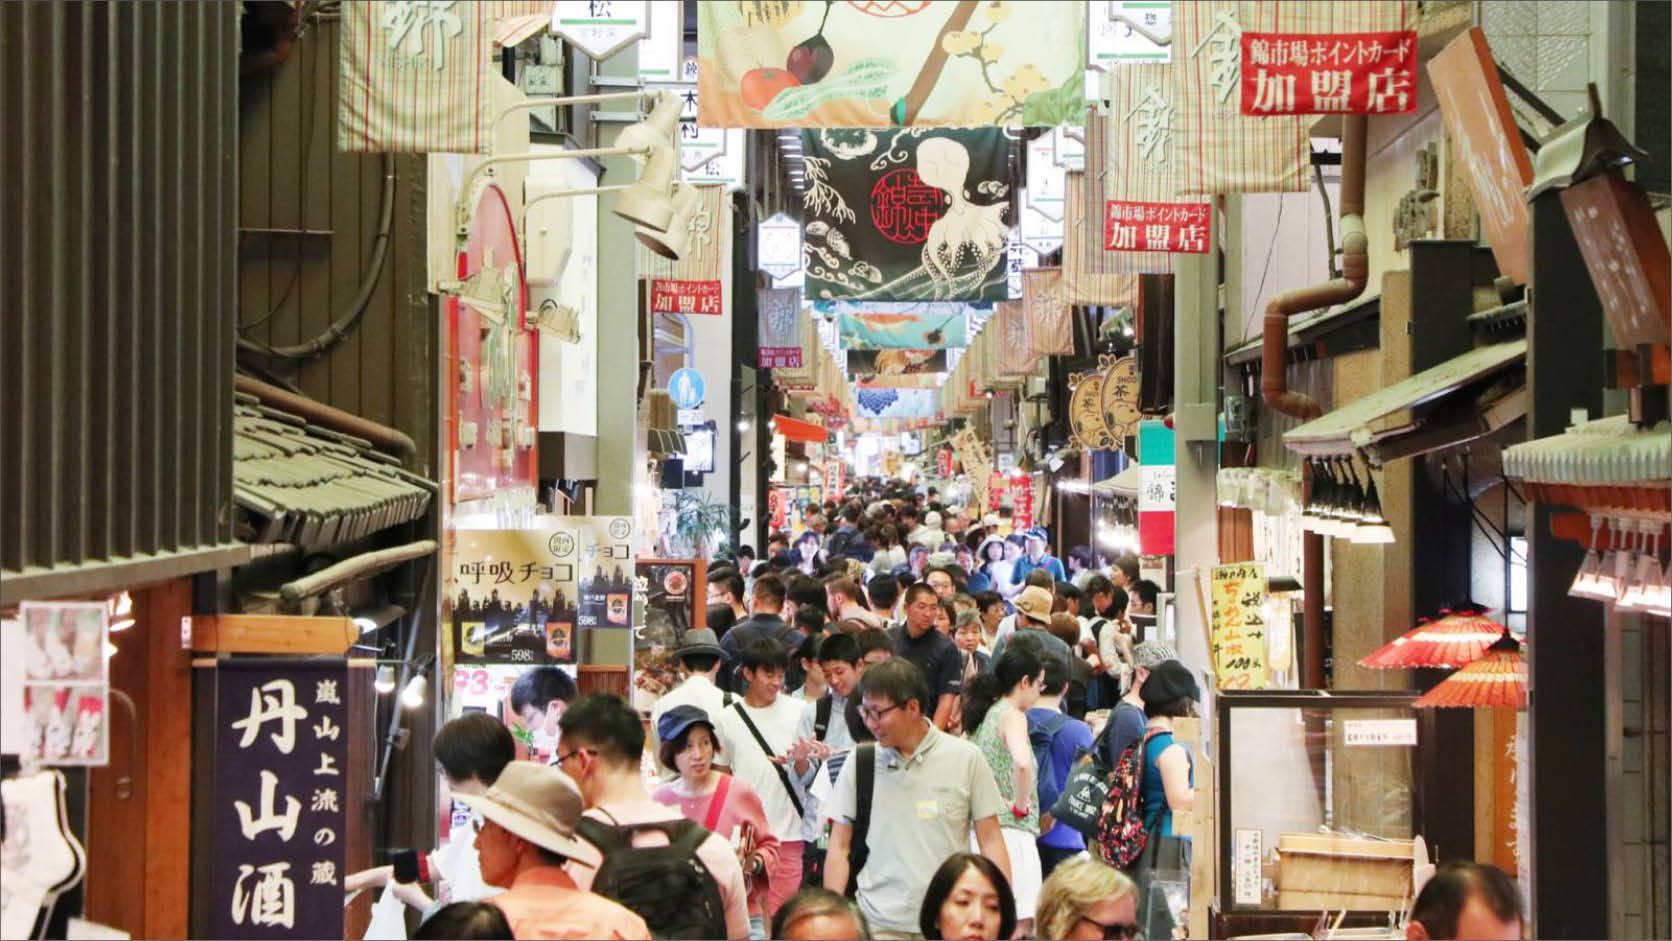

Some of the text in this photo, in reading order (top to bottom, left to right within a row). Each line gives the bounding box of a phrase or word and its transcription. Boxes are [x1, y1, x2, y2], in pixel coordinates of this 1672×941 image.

[1250, 38, 1411, 67] 錦市場ポイントカード
[1250, 67, 1412, 112] 加盟店
[1111, 203, 1206, 222] 錦市場ポイントカード
[1109, 222, 1206, 251] 加盟店
[654, 294, 720, 313] 加盟店
[454, 561, 573, 584] 呼吸チョコ
[310, 679, 340, 886] 嵐山上流の蔵
[231, 679, 308, 929] 丹山酒
